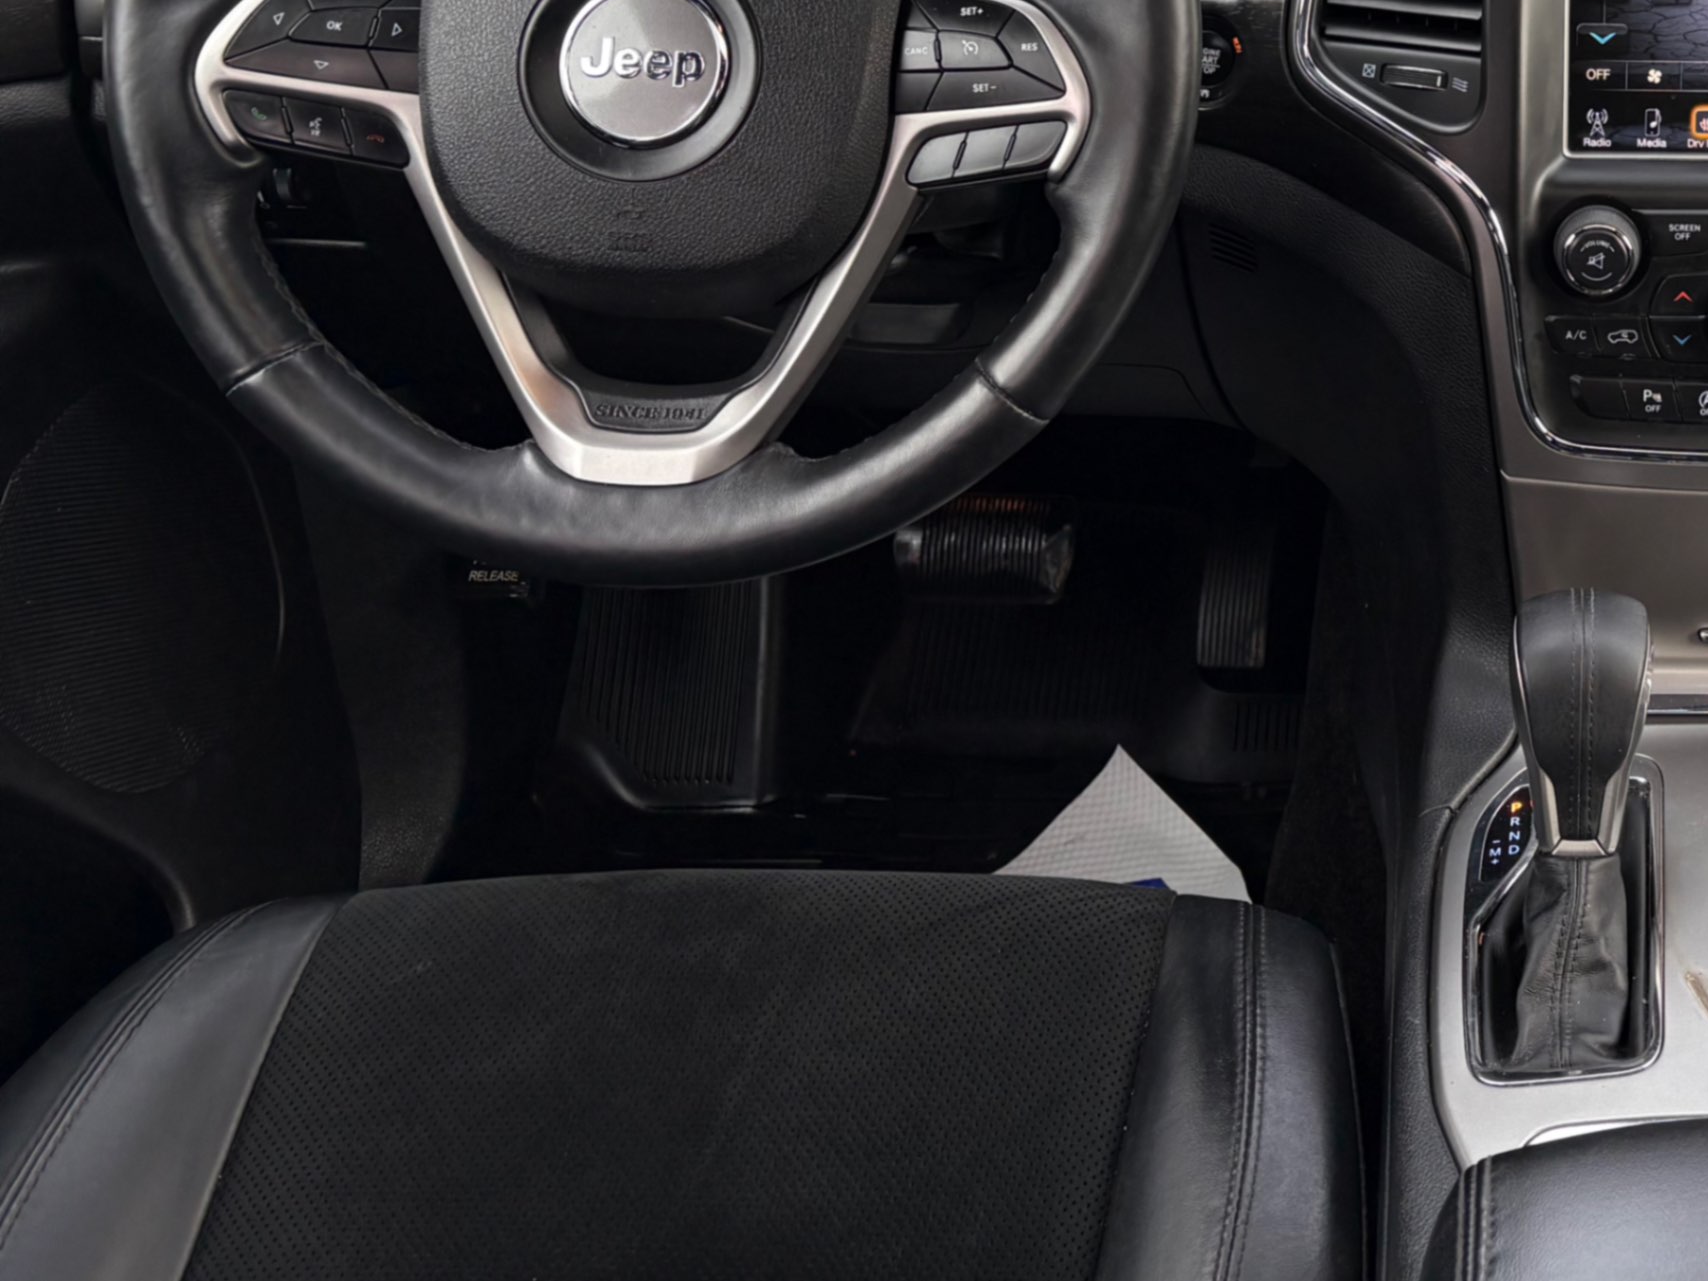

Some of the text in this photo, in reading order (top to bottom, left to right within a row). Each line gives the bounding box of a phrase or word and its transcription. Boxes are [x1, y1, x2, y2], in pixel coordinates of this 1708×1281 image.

[326, 20, 343, 32] OK
[1020, 42, 1038, 52] RES
[579, 36, 705, 88] Jeep
[1586, 68, 1611, 80] OFF
[1583, 137, 1611, 148] Radio
[1637, 137, 1667, 149] Media
[1687, 138, 1704, 149] Drv
[1669, 223, 1701, 233] SCREEN
[1674, 232, 1691, 241] OFF
[1565, 330, 1587, 342] A/C
[594, 404, 658, 420] SINCE
[1645, 404, 1662, 414] OFF
[468, 570, 520, 582] RELEASE
[1510, 801, 1522, 813] P
[1510, 817, 1521, 827] R
[1509, 831, 1520, 841] N
[1489, 847, 1501, 857] M
[1508, 845, 1520, 855] D
